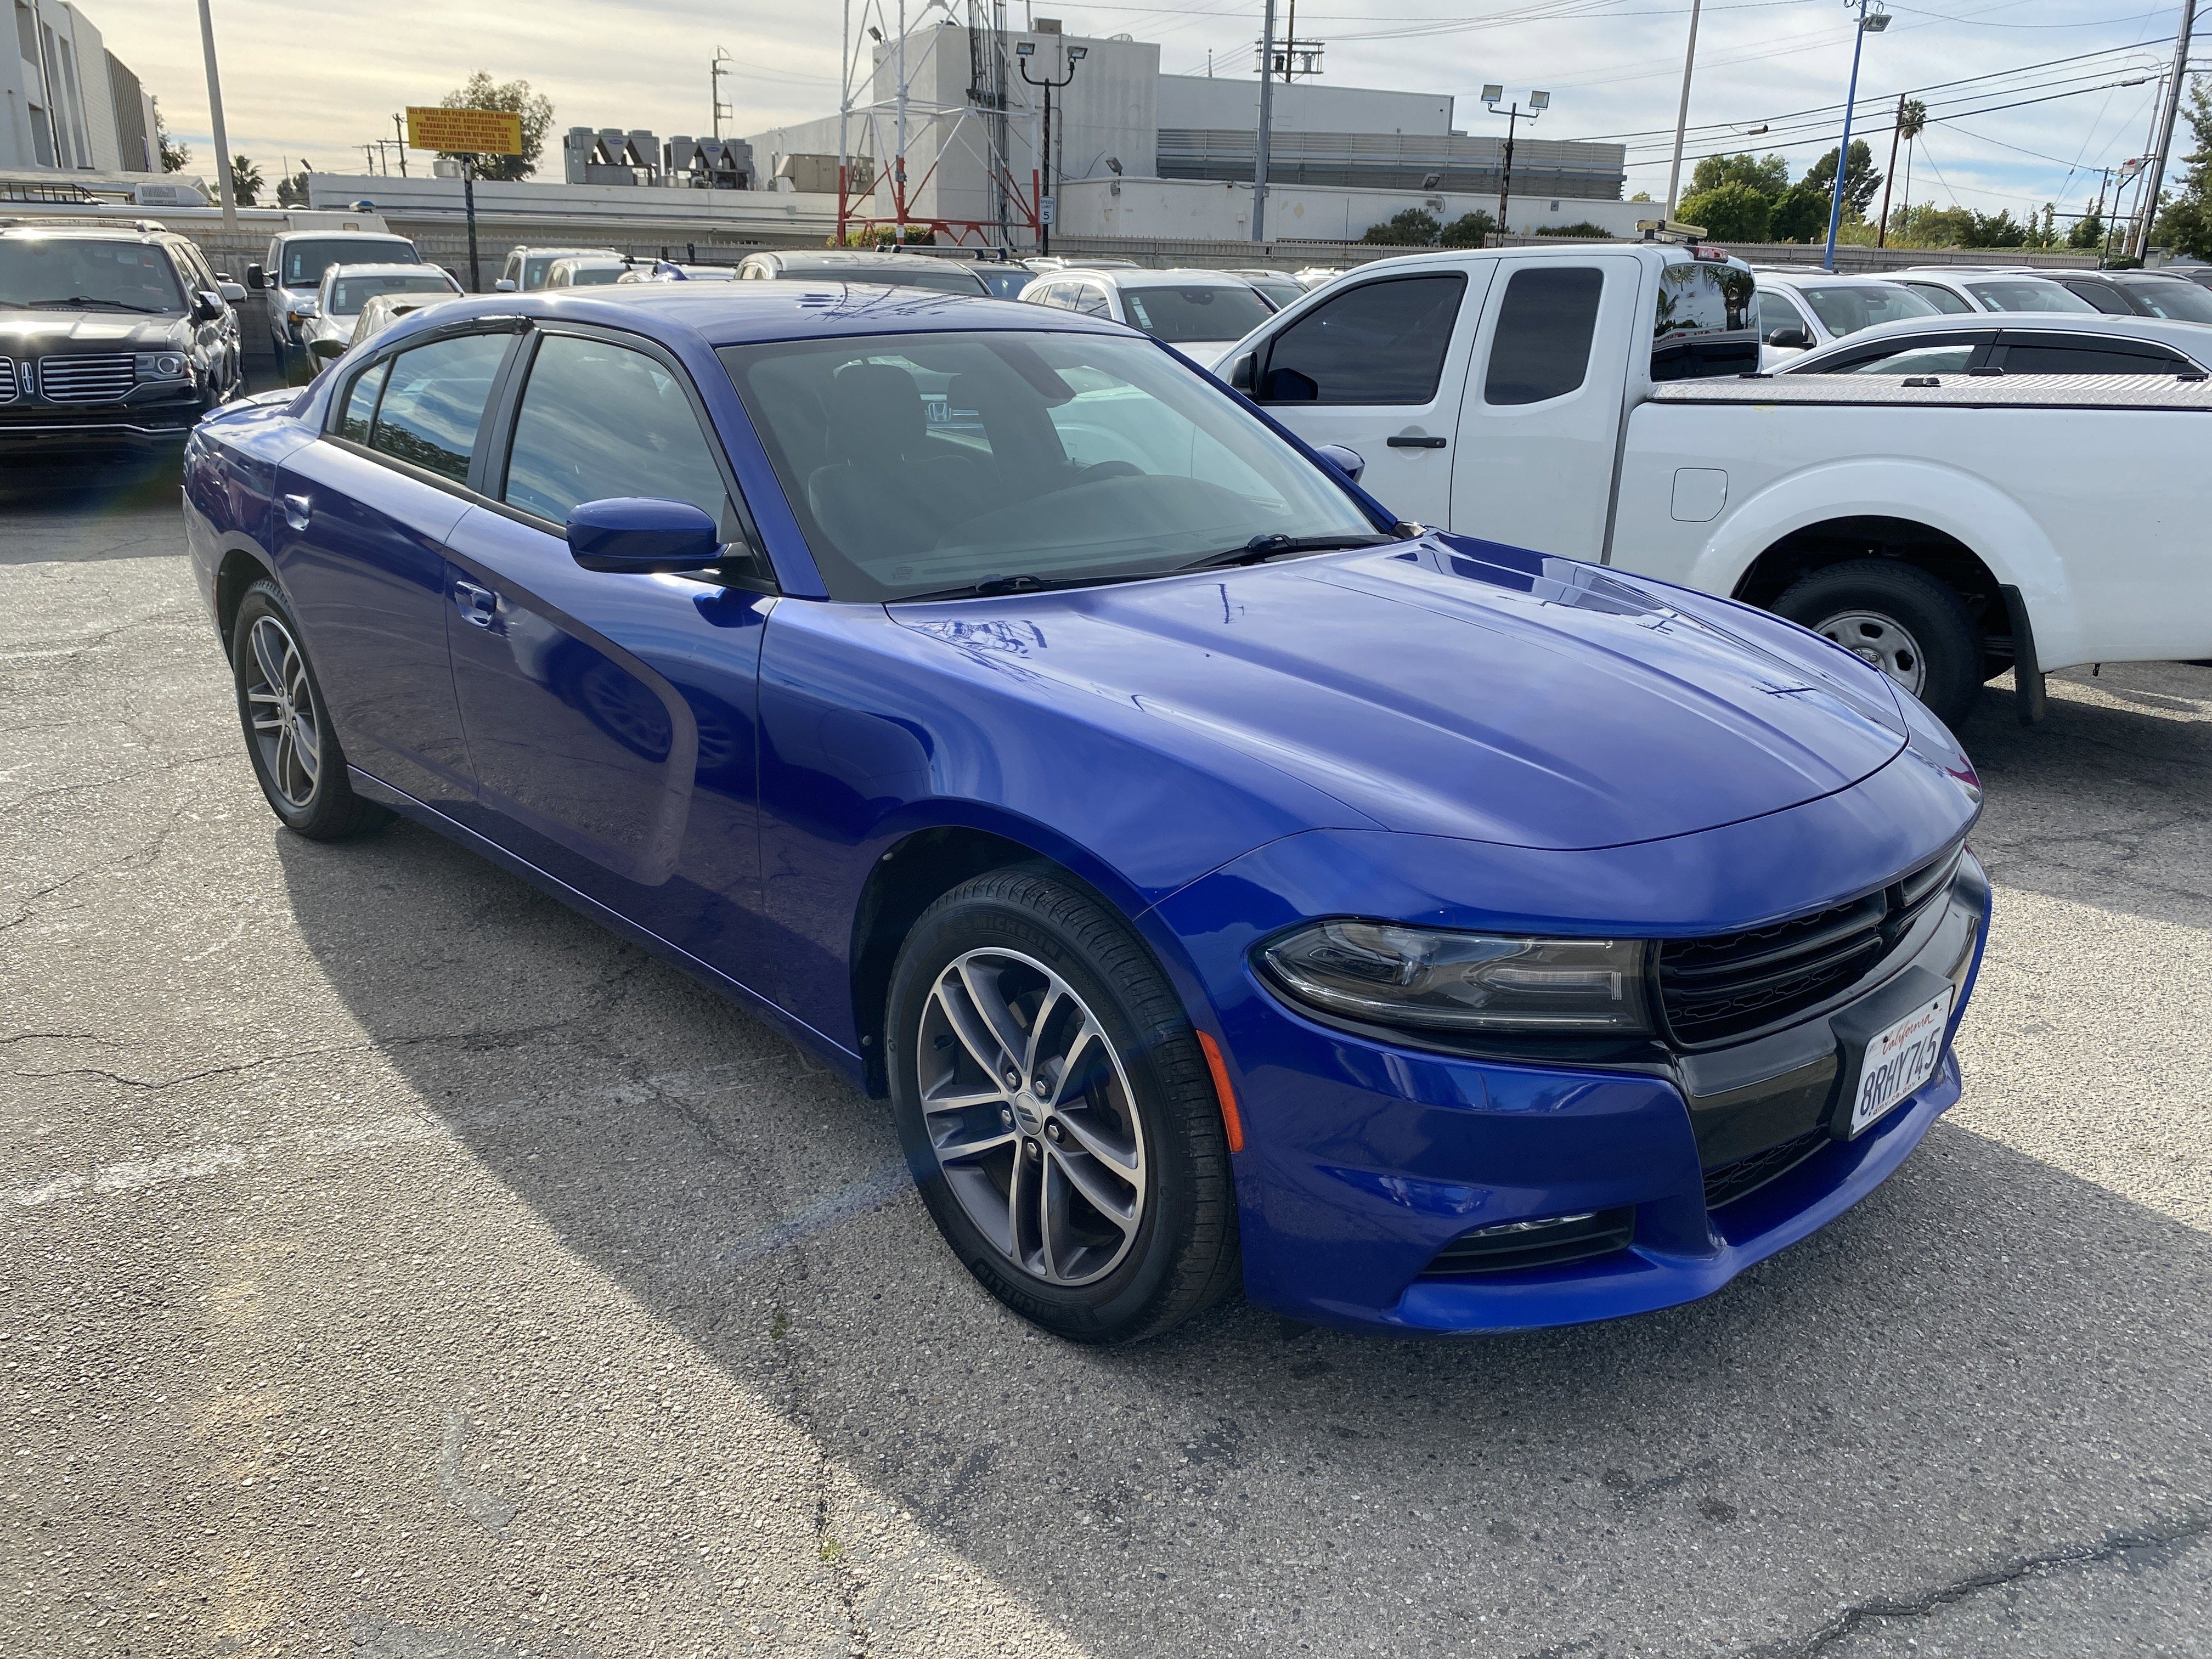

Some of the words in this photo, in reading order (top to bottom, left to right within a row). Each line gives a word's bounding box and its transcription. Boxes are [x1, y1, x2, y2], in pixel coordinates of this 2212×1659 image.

[1043, 211, 1049, 219] 5
[973, 914, 1059, 957] MICHELIN
[1882, 1013, 1934, 1055] California
[1860, 1026, 1941, 1116] 8RHY745
[1873, 1081, 1916, 1115] dmv.ca.gov
[976, 1262, 1058, 1321] MICHELIN
